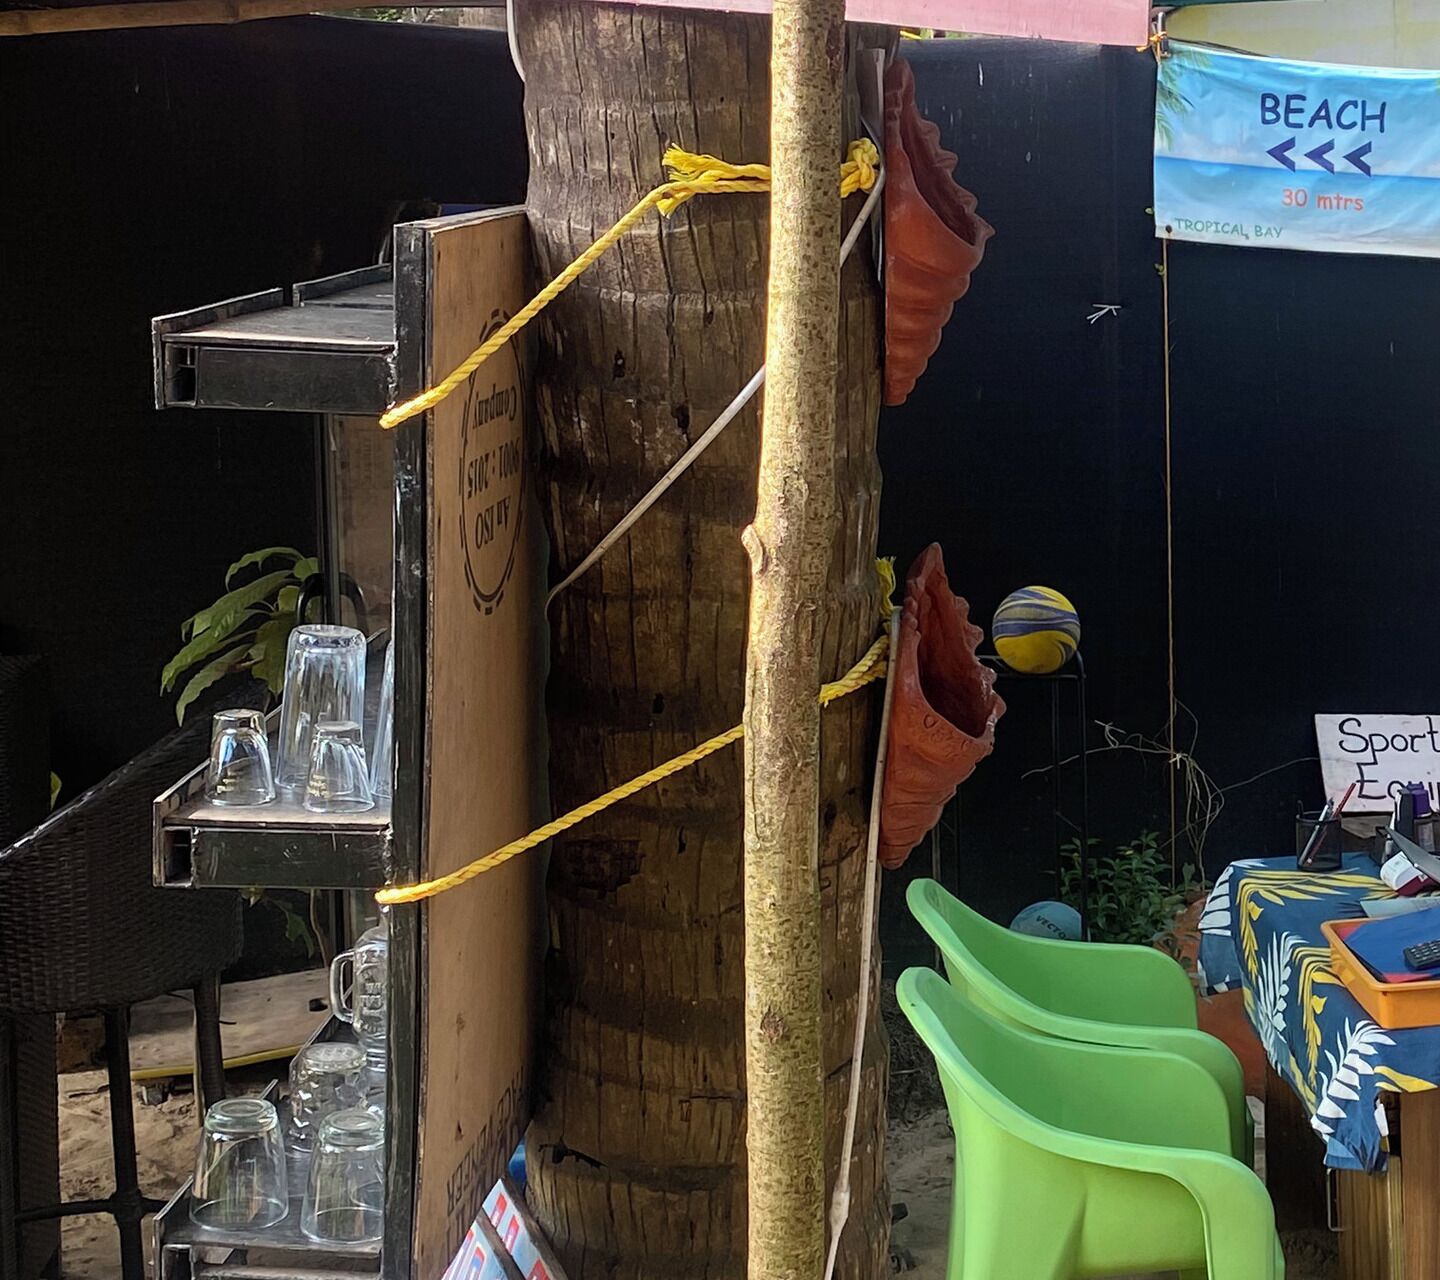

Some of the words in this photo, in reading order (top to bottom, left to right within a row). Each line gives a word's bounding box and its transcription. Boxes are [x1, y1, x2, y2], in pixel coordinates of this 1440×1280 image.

[1260, 92, 1387, 133] BEACH
[1281, 188, 1309, 208] 30
[1316, 191, 1365, 211] mtrs
[1253, 223, 1284, 240] BAY
[473, 383, 516, 429] Company
[468, 453, 489, 498] 2015
[475, 505, 495, 550] ISO
[497, 497, 511, 528] An
